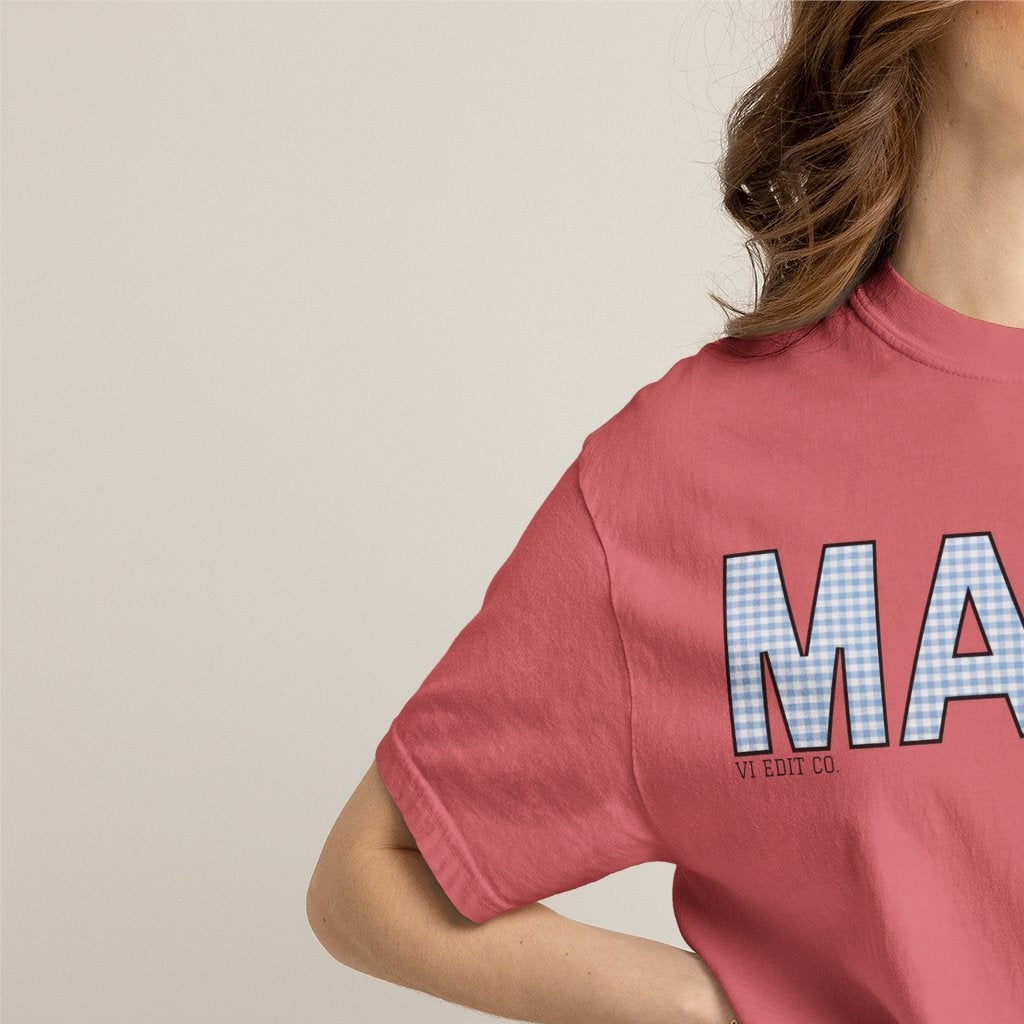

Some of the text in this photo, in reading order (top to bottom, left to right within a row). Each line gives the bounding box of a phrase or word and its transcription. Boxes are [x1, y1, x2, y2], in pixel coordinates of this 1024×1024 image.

[735, 755, 840, 779] VI EDIT CO.
